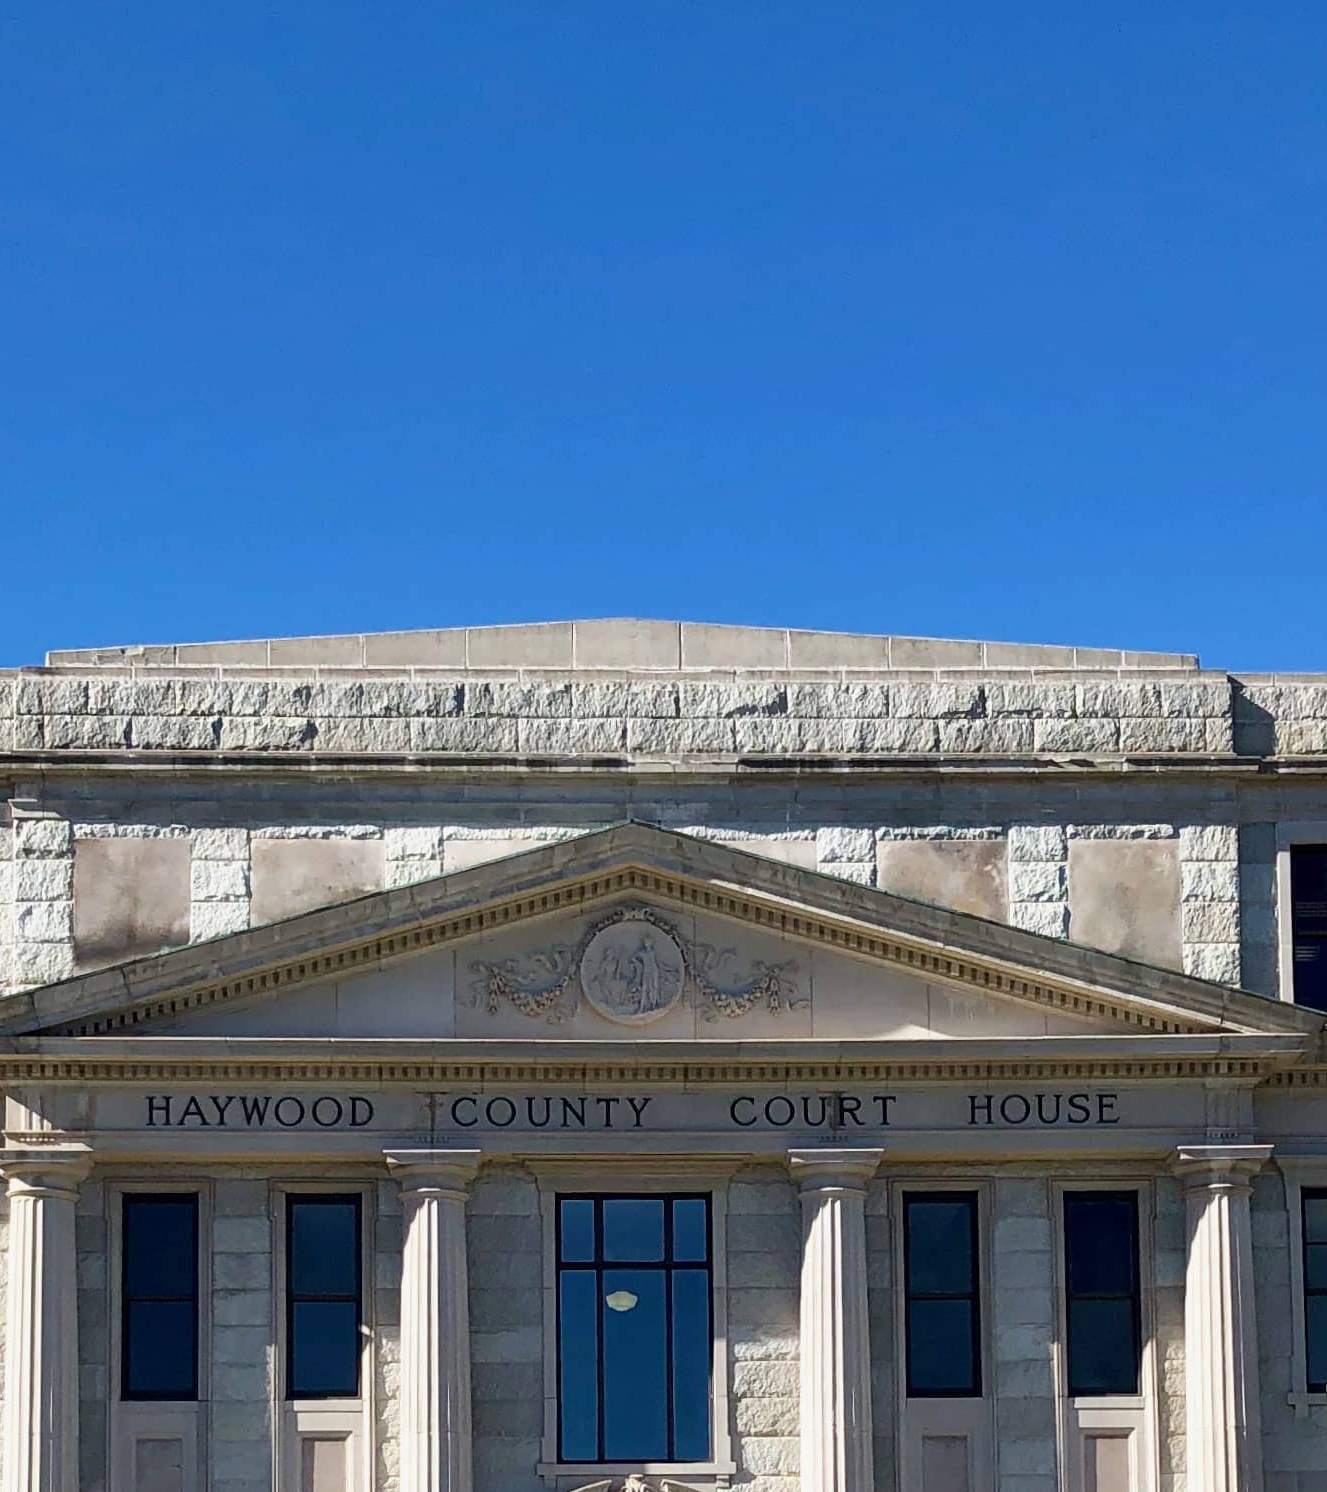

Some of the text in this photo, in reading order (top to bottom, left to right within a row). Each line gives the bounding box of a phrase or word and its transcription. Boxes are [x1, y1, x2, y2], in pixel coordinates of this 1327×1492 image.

[145, 1094, 1121, 1127] HAYWOOD COUNTY COURT HOUSE
